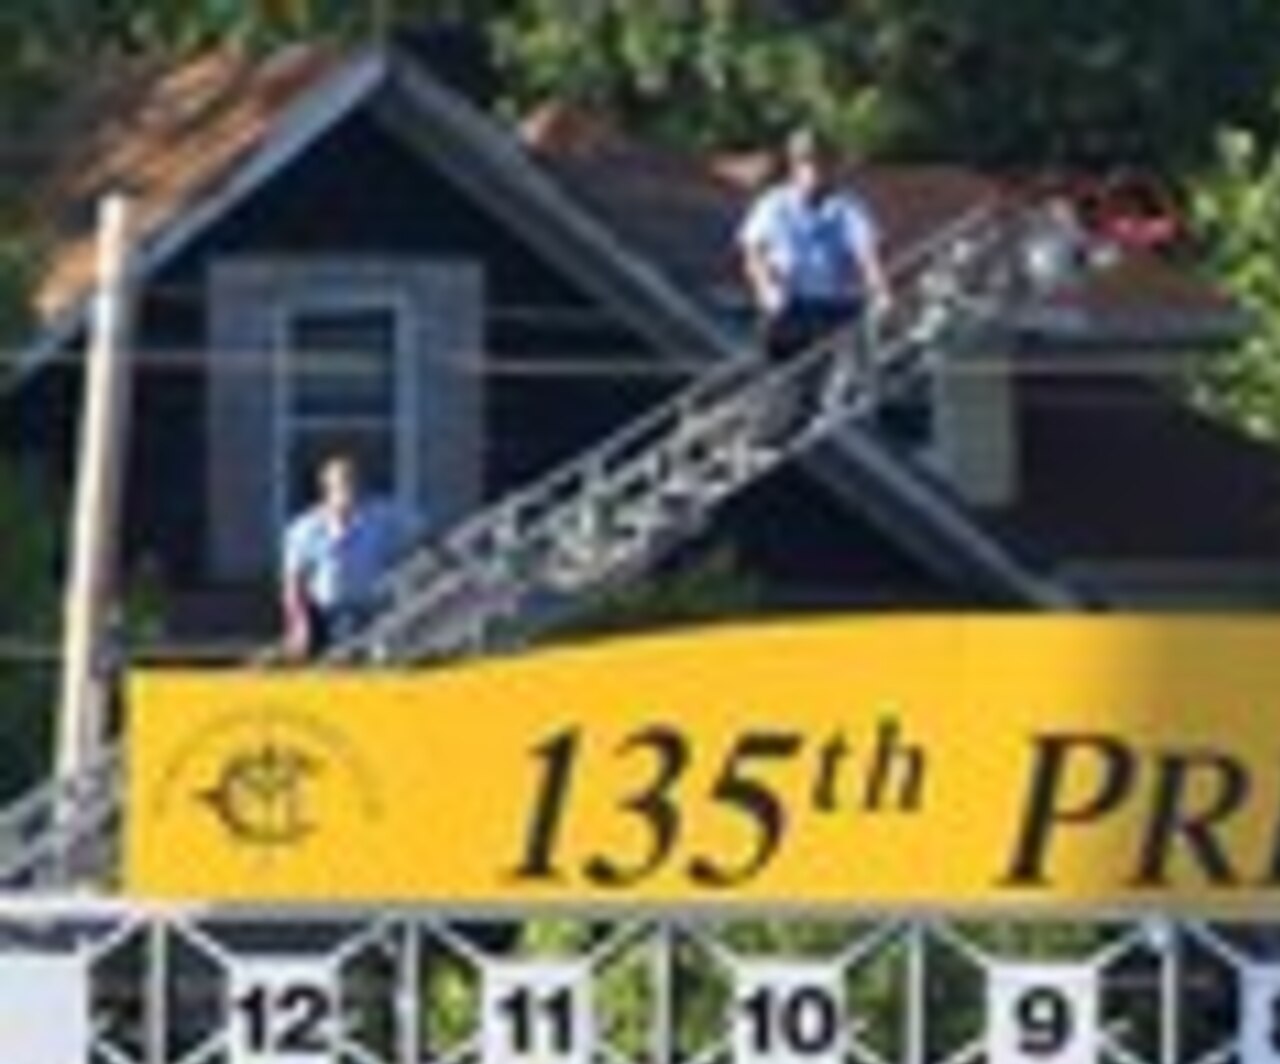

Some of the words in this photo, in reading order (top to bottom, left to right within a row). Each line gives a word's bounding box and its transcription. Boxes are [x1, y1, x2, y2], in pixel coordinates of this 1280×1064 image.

[504, 716, 926, 887] 135th
[237, 984, 331, 1053] 12
[500, 986, 573, 1054] 11
[740, 987, 841, 1055] 10
[1015, 986, 1073, 1056] 9
